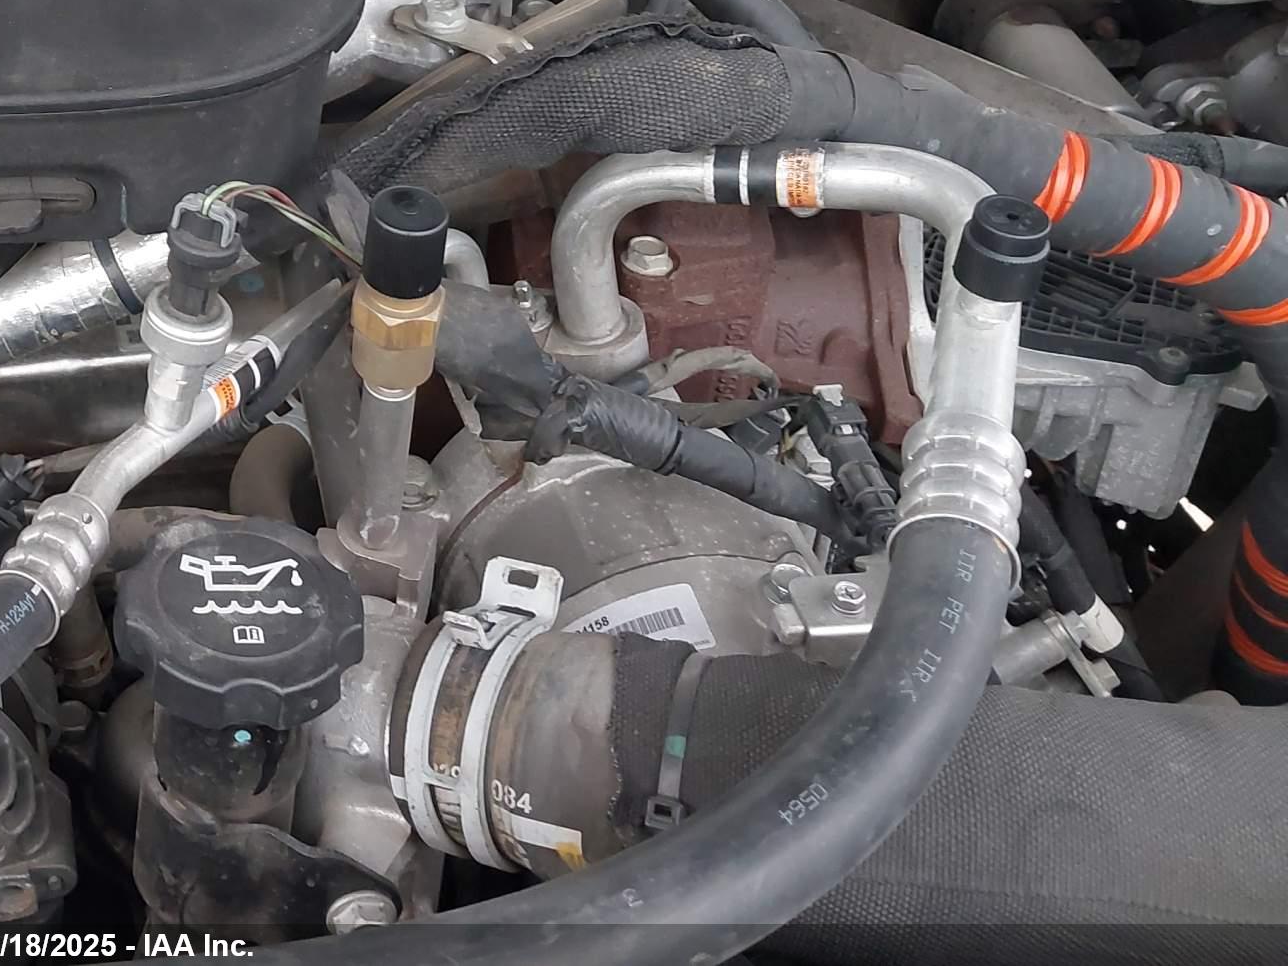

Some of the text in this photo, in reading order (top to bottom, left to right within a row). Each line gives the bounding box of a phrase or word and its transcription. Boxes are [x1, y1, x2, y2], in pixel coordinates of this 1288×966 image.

[939, 597, 964, 634] PET
[491, 779, 532, 814] 084
[777, 783, 829, 825] 0564
